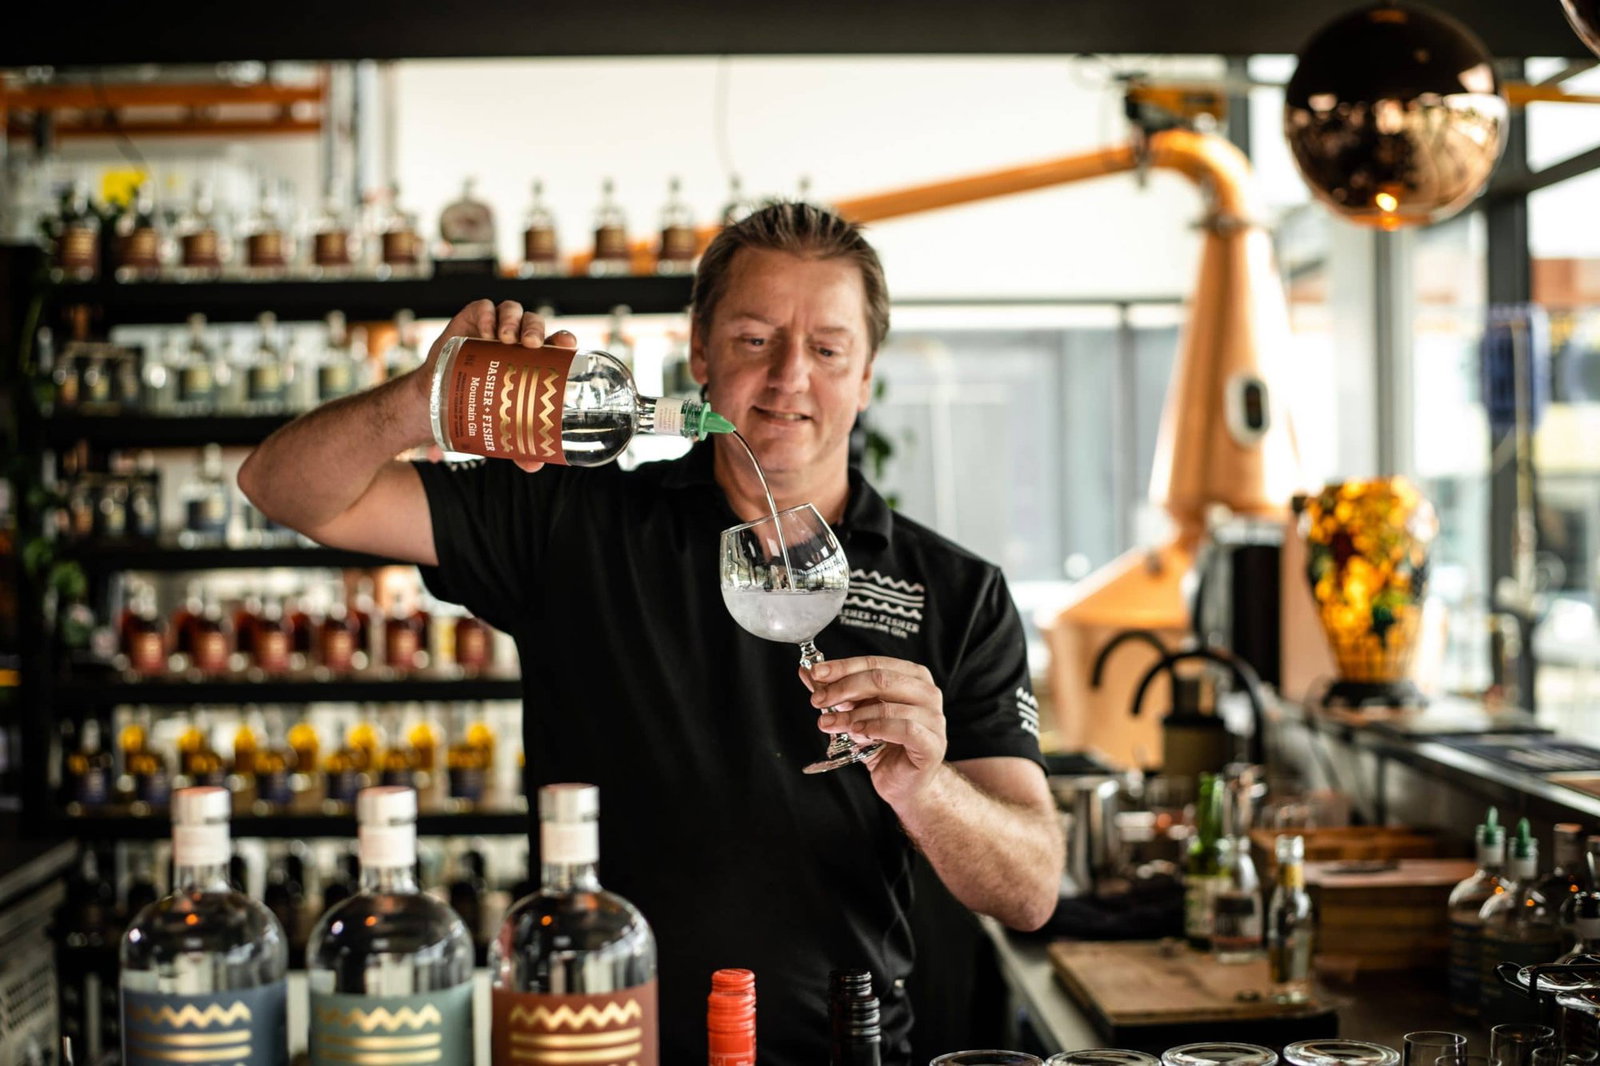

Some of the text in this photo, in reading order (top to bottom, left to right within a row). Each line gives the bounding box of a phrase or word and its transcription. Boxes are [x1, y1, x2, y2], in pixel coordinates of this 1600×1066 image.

[467, 376, 481, 422] Mountain
[482, 360, 500, 406] DASHER
[468, 422, 477, 437] Gin
[482, 414, 496, 452] FISHER
[840, 615, 908, 638] Tasmanian Gin
[841, 608, 871, 621] SHER
[879, 613, 920, 634] FISHER
